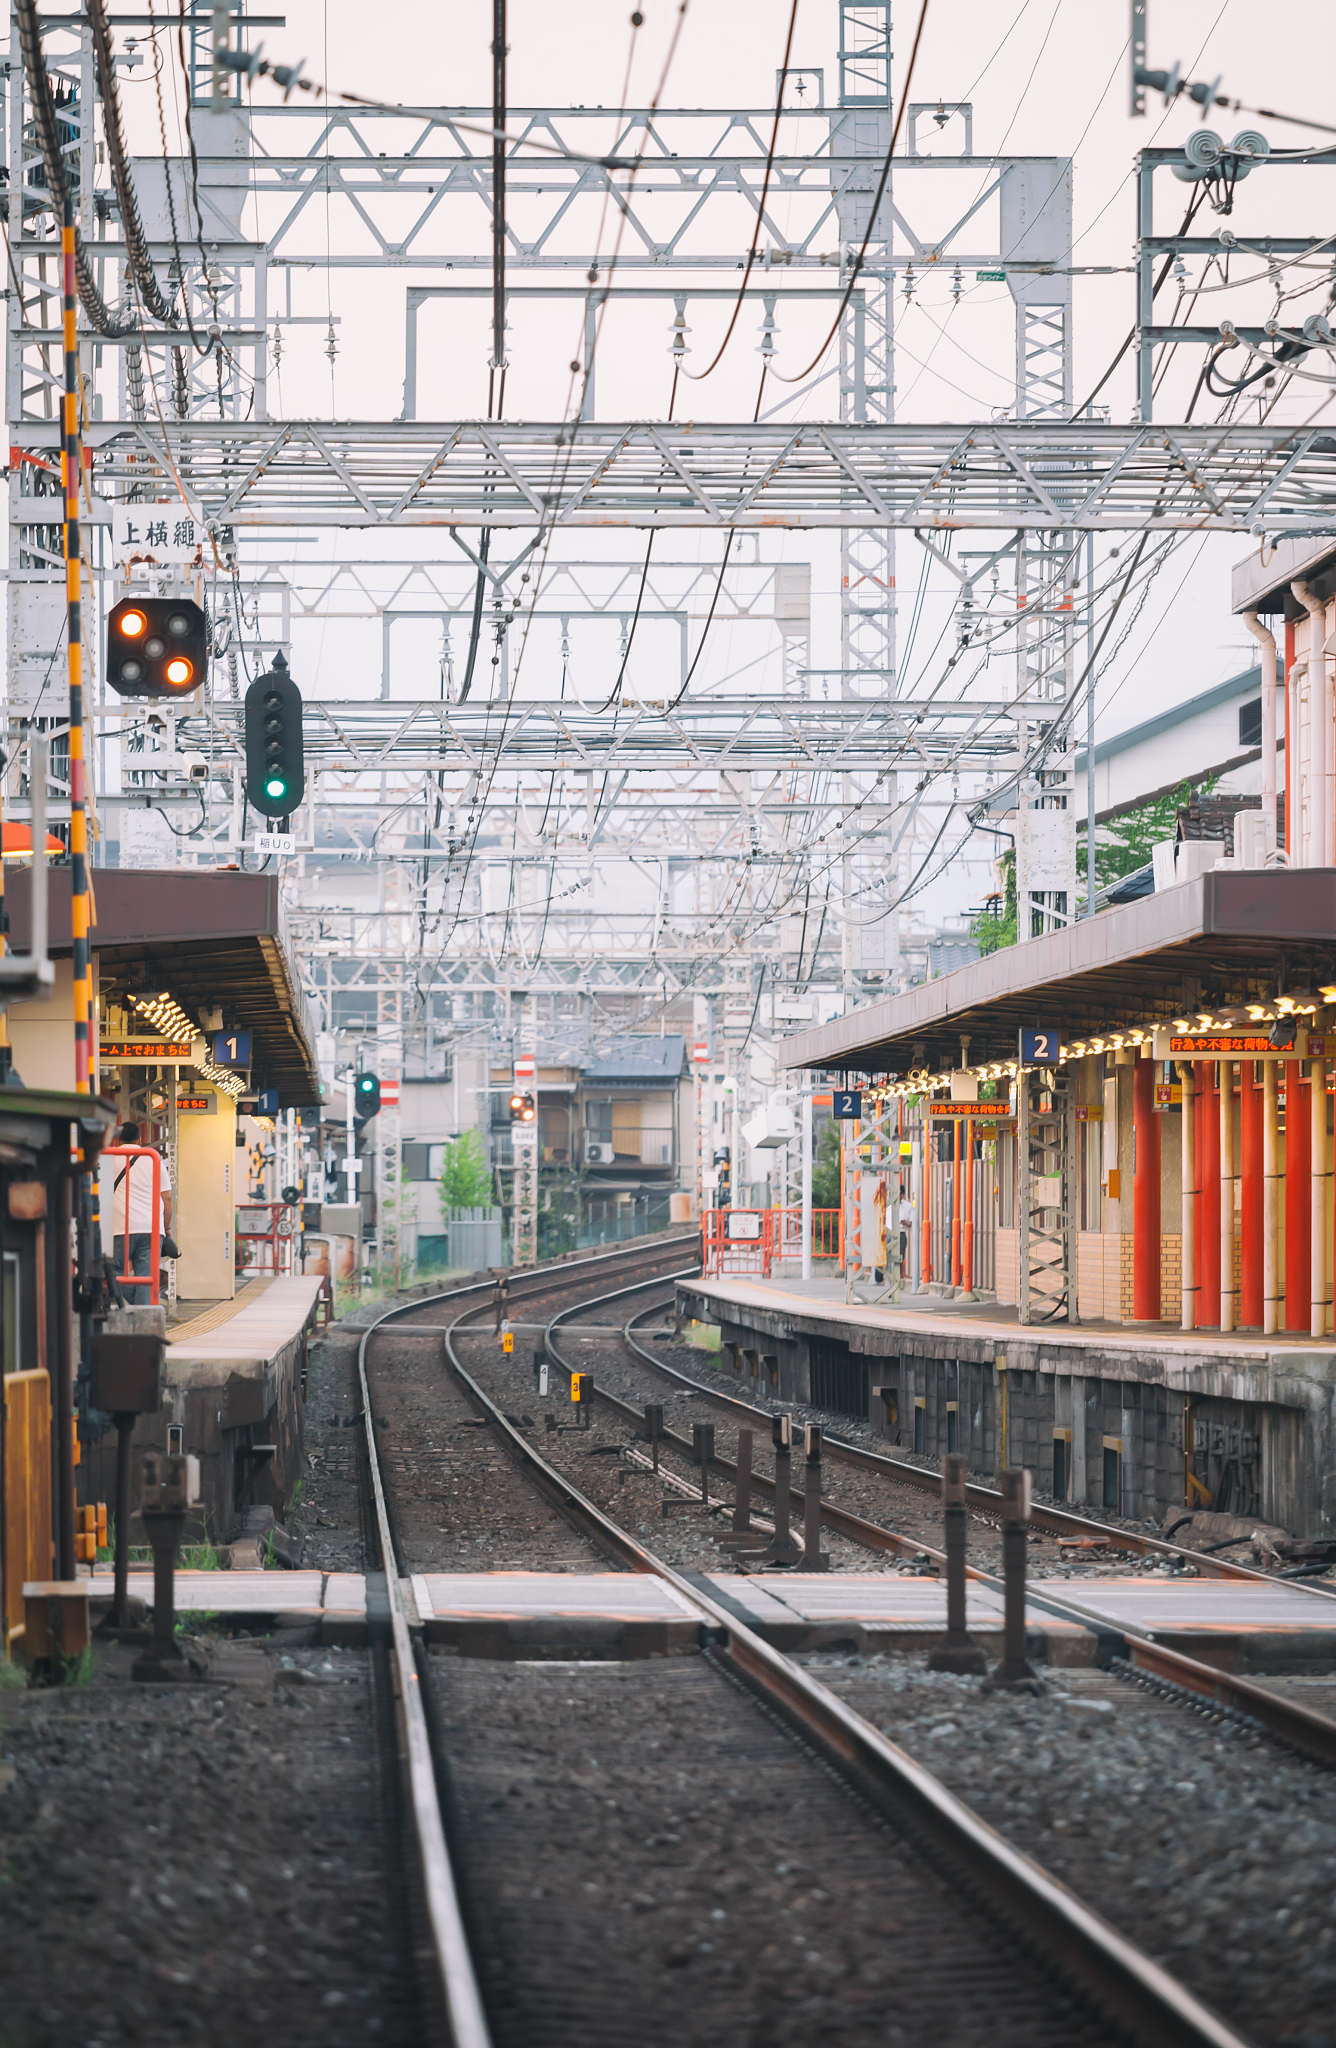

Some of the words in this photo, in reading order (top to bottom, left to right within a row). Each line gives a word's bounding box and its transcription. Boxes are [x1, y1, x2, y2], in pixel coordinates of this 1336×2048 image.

[226, 1037, 237, 1060] 1
[1033, 1035, 1049, 1058] 2
[260, 1093, 268, 1109] 1
[842, 1096, 853, 1112] 2
[280, 1223, 289, 1233] 65
